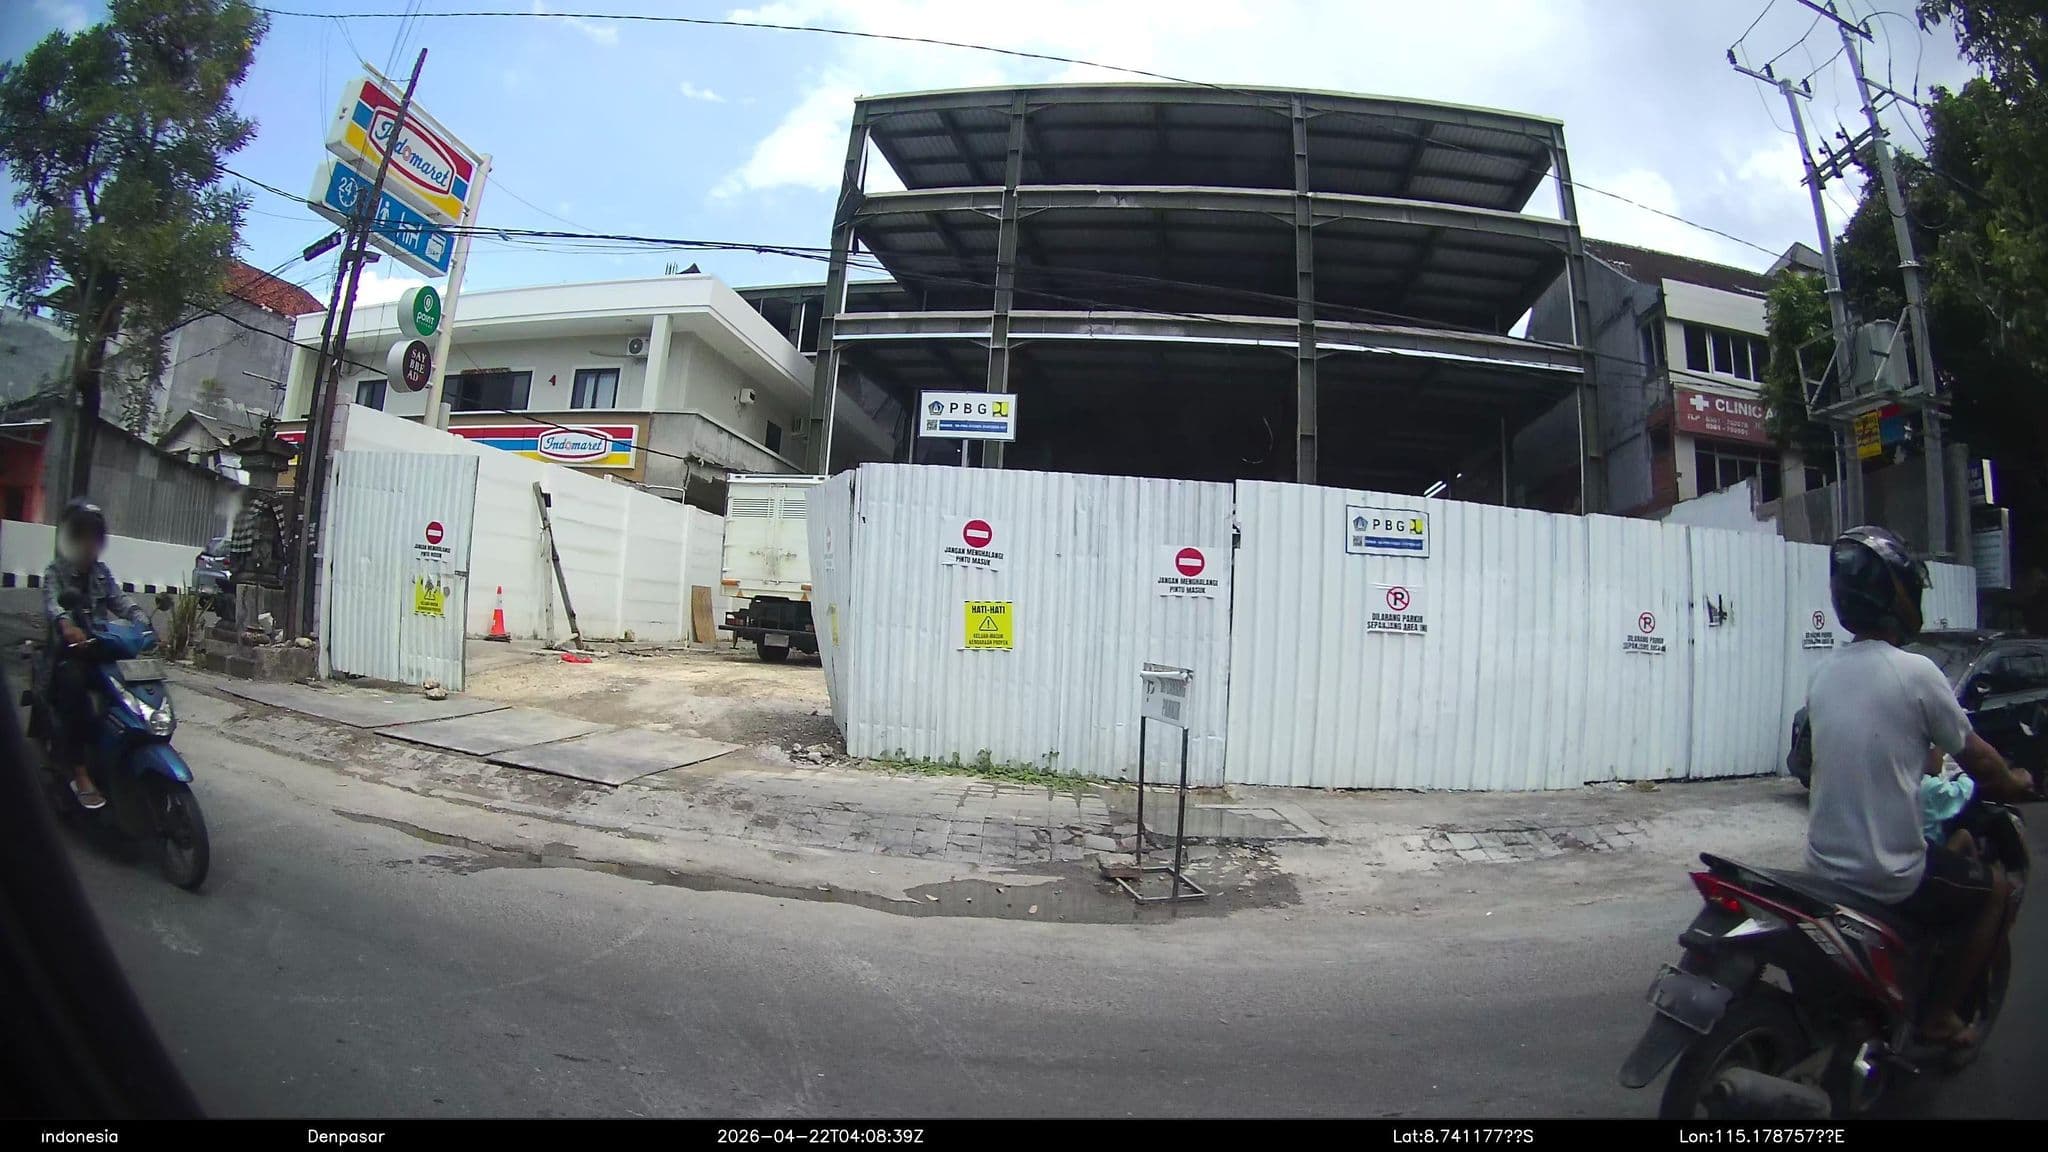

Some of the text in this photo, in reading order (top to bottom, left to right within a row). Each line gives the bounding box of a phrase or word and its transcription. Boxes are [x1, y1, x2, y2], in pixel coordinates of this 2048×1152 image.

[375, 121, 450, 187] Idomaret
[339, 177, 353, 196] 24
[411, 349, 427, 363] SAY
[409, 359, 425, 374] BRE
[407, 372, 419, 382] AD
[543, 437, 602, 451] Indomaret
[971, 557, 991, 566] MASUK
[1157, 577, 1179, 585] JANGAN
[971, 605, 1006, 614] HATI-HATI
